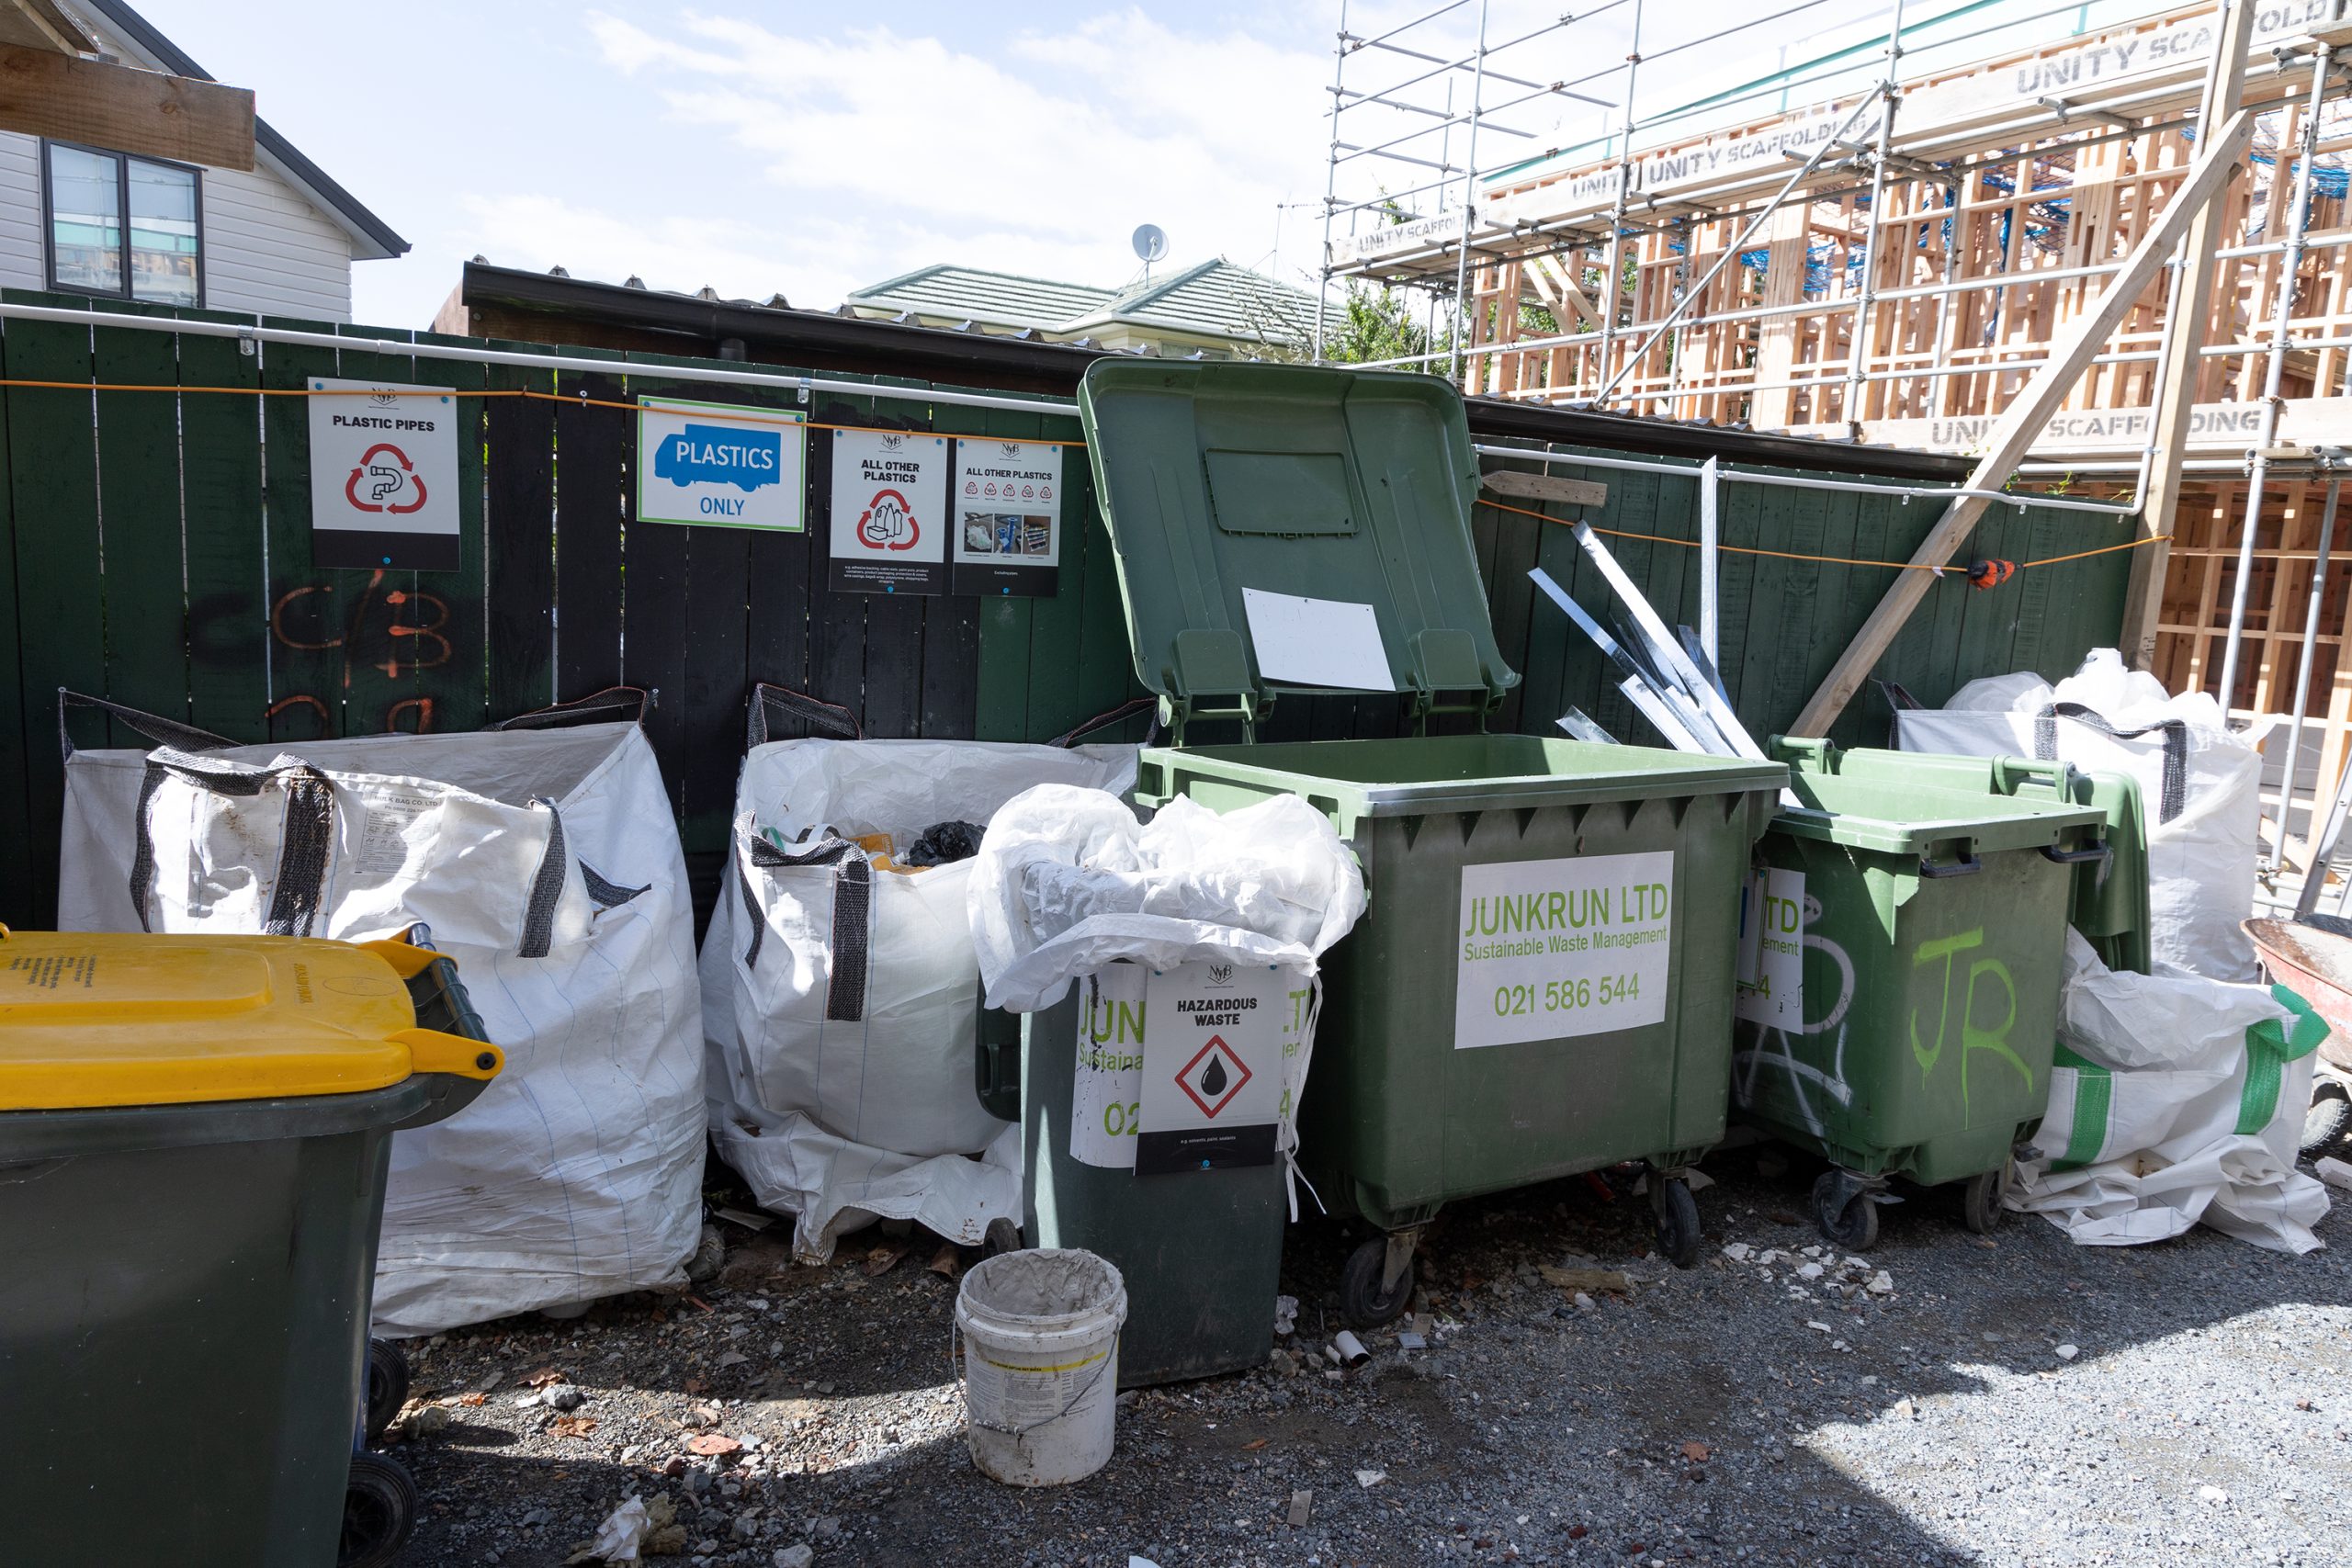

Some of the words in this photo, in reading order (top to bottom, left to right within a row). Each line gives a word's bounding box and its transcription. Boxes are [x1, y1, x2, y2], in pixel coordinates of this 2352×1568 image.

[2017, 39, 2139, 94] UNITY
[1649, 148, 1722, 184] UNITY
[1359, 228, 1403, 253] UNITY
[333, 415, 392, 429] PLASTIC
[395, 420, 435, 432] PIPES
[1932, 419, 1998, 446] UNI
[2048, 410, 2262, 438] SCAFFDING
[676, 441, 774, 469] PLASTICS
[861, 459, 883, 469] ALL
[885, 461, 920, 472] OTHER
[864, 471, 916, 483] PLASTICS
[966, 468, 983, 476] ALL
[984, 468, 1011, 478] OTHER
[1012, 470, 1052, 480] PLASTICS
[700, 497, 745, 516] ONLY
[1464, 888, 1609, 937] JUNKRUN
[1621, 883, 1668, 924] LTD
[1766, 896, 1799, 933] TD
[1464, 937, 1544, 962] Sustainable
[1548, 934, 1589, 953] Waste
[1592, 925, 1668, 949] Management
[1762, 938, 1799, 956] ement
[1177, 998, 1258, 1012] HAZARDOUS
[1494, 983, 1535, 1017] 021
[1544, 978, 1590, 1011] 586
[1599, 972, 1640, 1006] 544
[1194, 1013, 1240, 1027] WASTE
[1079, 1042, 1143, 1071] Sustaina
[1103, 1102, 1140, 1136] 02
